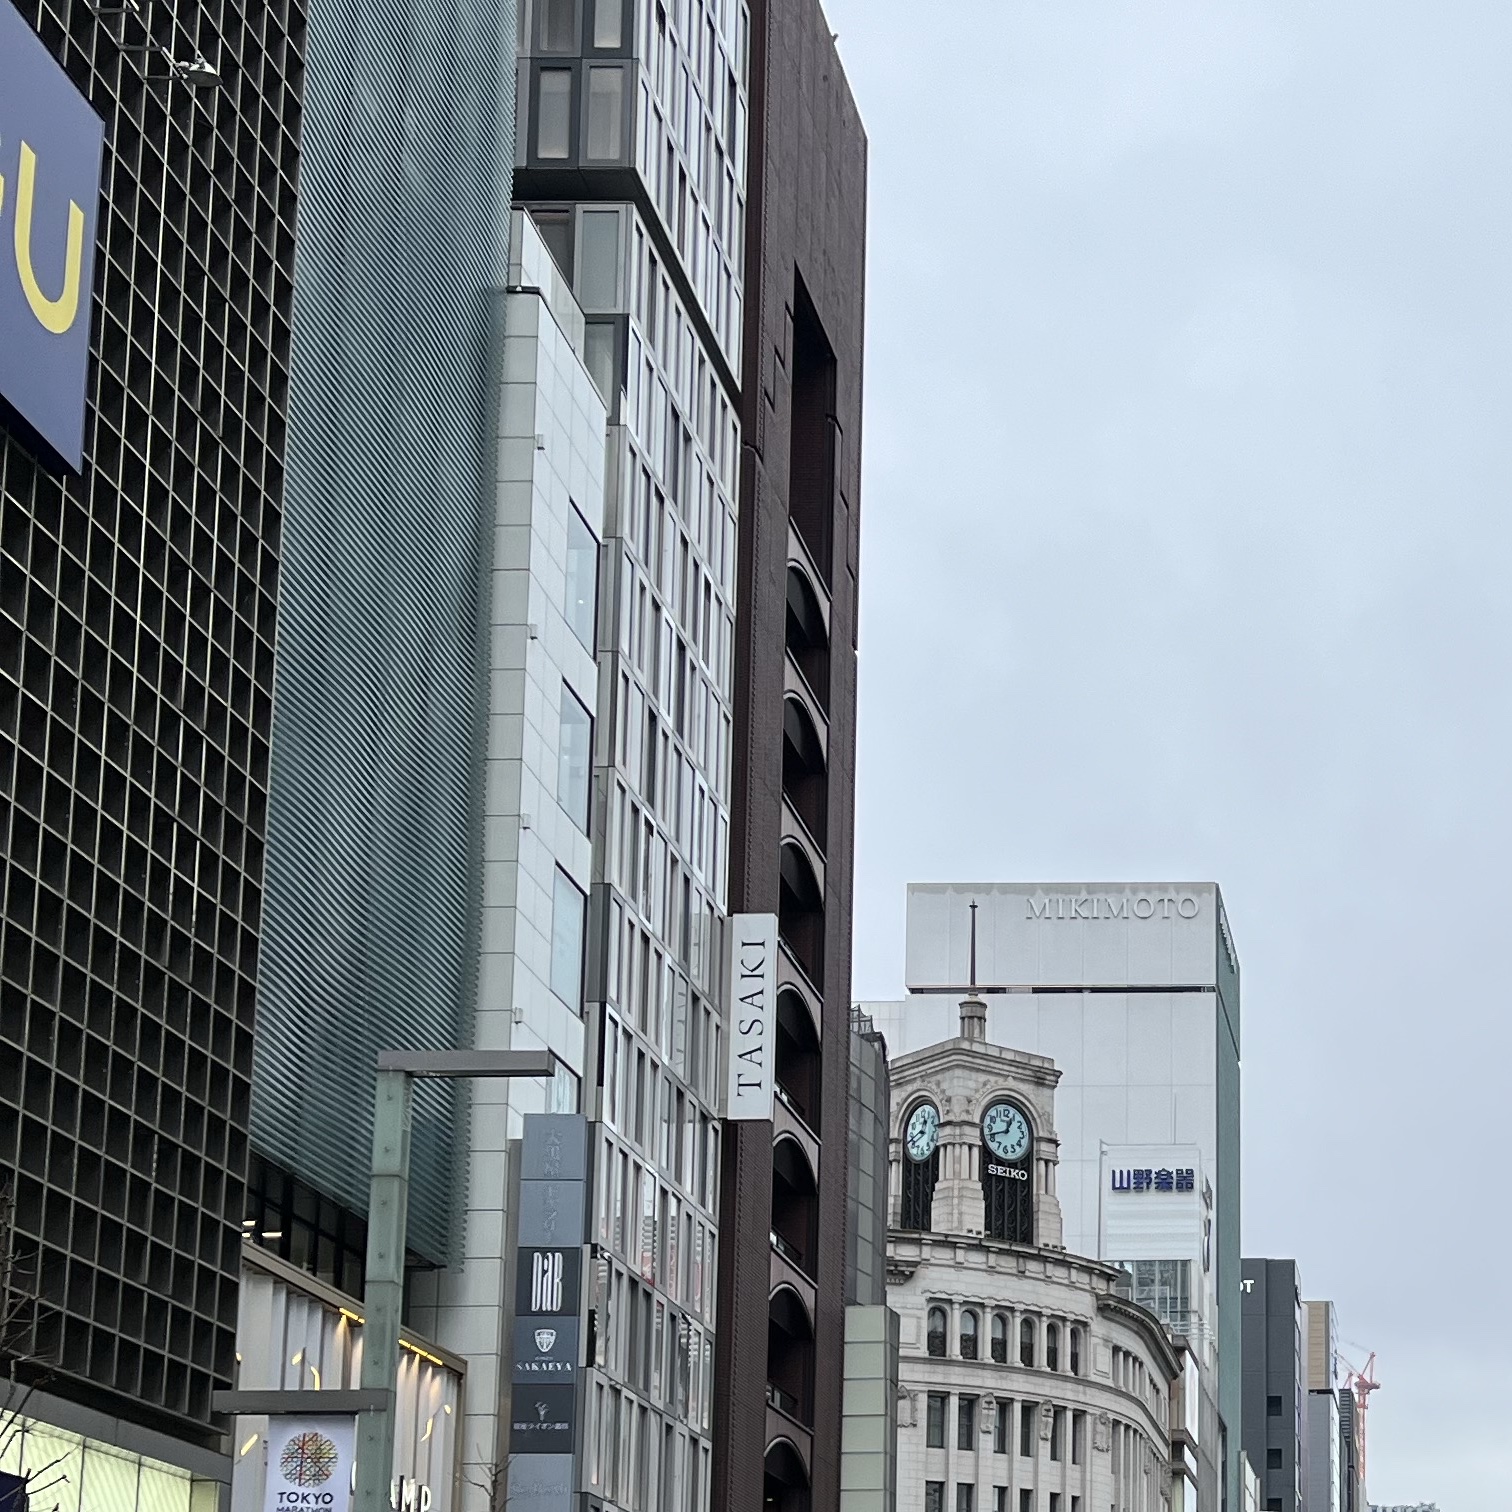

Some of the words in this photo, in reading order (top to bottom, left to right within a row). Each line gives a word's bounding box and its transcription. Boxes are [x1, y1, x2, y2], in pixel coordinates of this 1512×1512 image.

[0, 128, 84, 335] U
[1025, 897, 1200, 920] MIKIMOTO
[736, 939, 767, 1098] TASAKI
[987, 1164, 1028, 1181] SEIKO
[1111, 1168, 1195, 1193] 山野楽器
[277, 1492, 334, 1505] TOKYO
